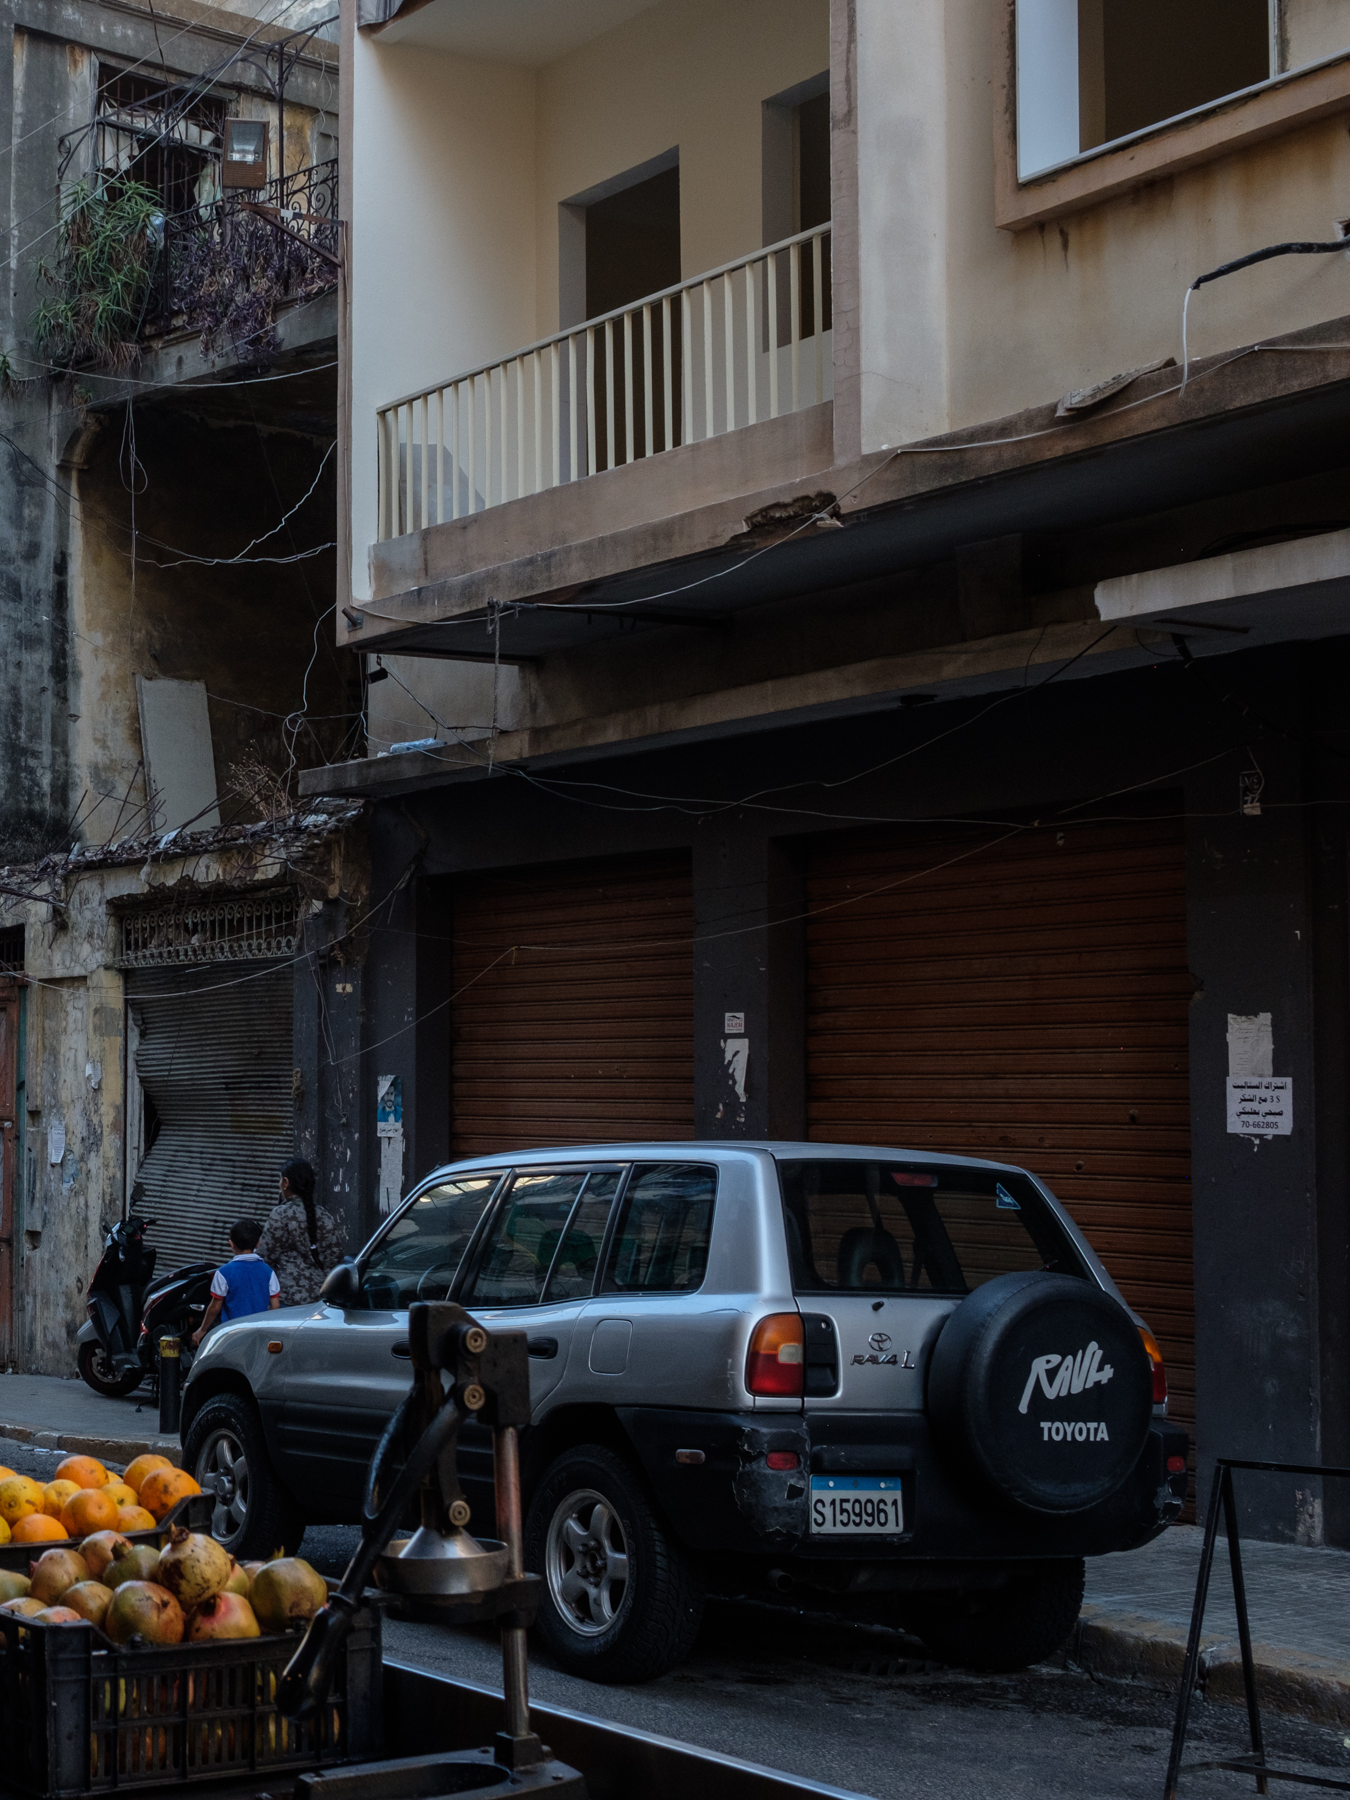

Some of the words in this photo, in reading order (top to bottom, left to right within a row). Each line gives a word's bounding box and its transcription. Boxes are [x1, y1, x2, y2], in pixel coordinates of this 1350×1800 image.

[1263, 1081, 1287, 1092] اشتراك
[1238, 1094, 1257, 1104] الشكر
[1258, 1096, 1267, 1104] مع
[1240, 1120, 1279, 1129] 70-662805
[850, 1353, 899, 1366] RAV4
[1016, 1340, 1115, 1415] RAV4
[1039, 1421, 1110, 1442] TOYOTA
[813, 1497, 900, 1528] S159961
